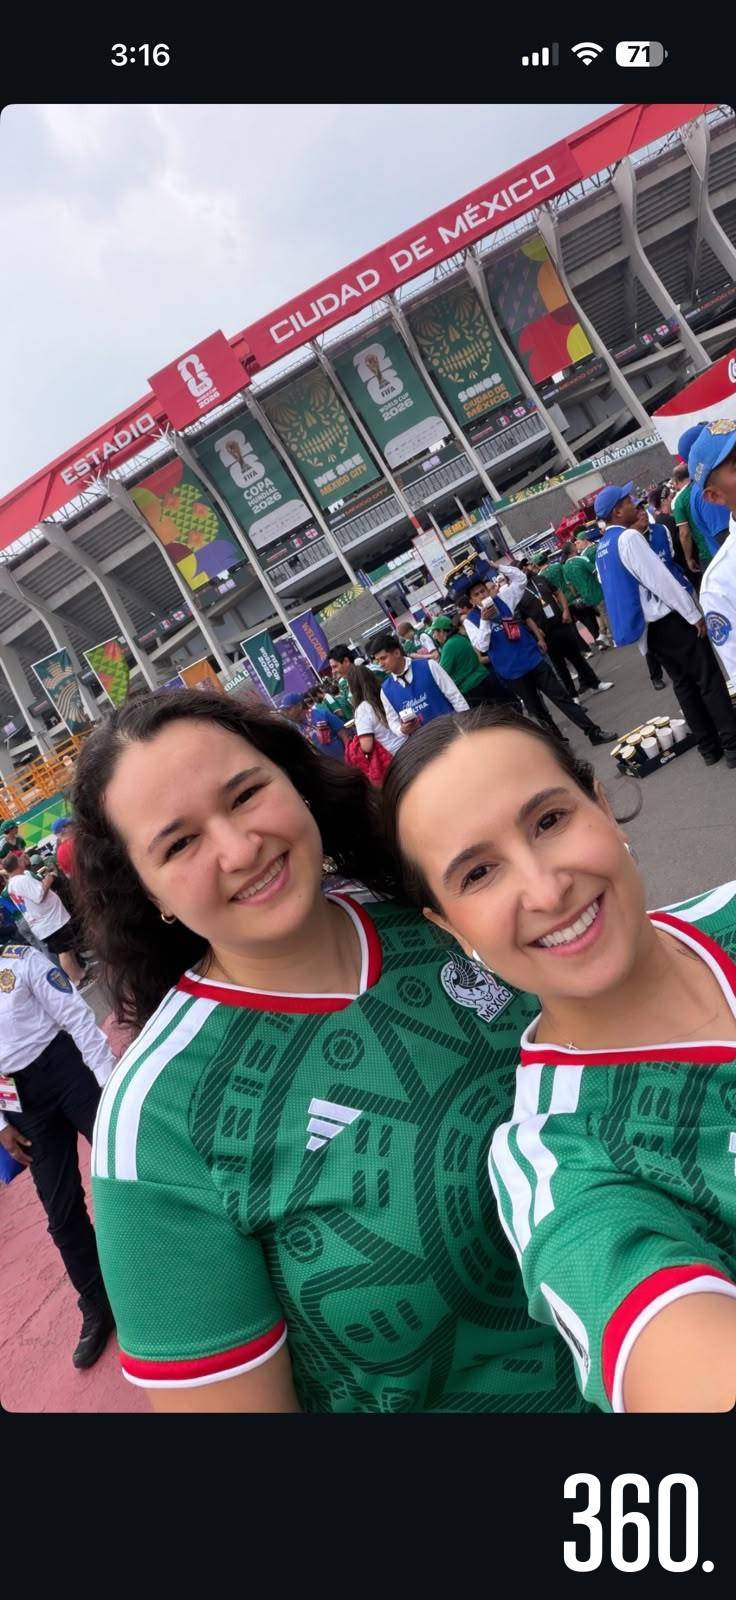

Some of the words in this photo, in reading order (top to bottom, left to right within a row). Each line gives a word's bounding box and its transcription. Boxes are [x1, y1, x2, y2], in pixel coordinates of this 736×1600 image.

[269, 268, 381, 344] CIUDAD
[389, 236, 434, 273] DE
[437, 164, 555, 245] MÉXICO
[198, 390, 220, 409] 2026
[380, 385, 397, 398] FIFA
[458, 373, 502, 403] SOMOS
[379, 398, 399, 414] WORLD
[398, 391, 410, 402] CUP
[382, 398, 414, 421] 2026
[463, 389, 495, 411] CIUDAD
[60, 412, 157, 486] ESTADIO
[591, 454, 612, 469] FIFA
[610, 440, 644, 460] WORLD
[242, 469, 259, 482] FIFA
[313, 469, 337, 488] WE
[335, 453, 364, 476] ARE
[320, 473, 350, 496] MEXICO
[350, 463, 368, 480] CITY
[243, 477, 275, 500] COPA
[247, 486, 278, 507] MUNDIAL
[251, 491, 282, 514] 2026
[257, 656, 273, 679] 2026
[259, 646, 275, 669] WORLD
[271, 668, 281, 681] CUP
[270, 653, 280, 669] FIFA
